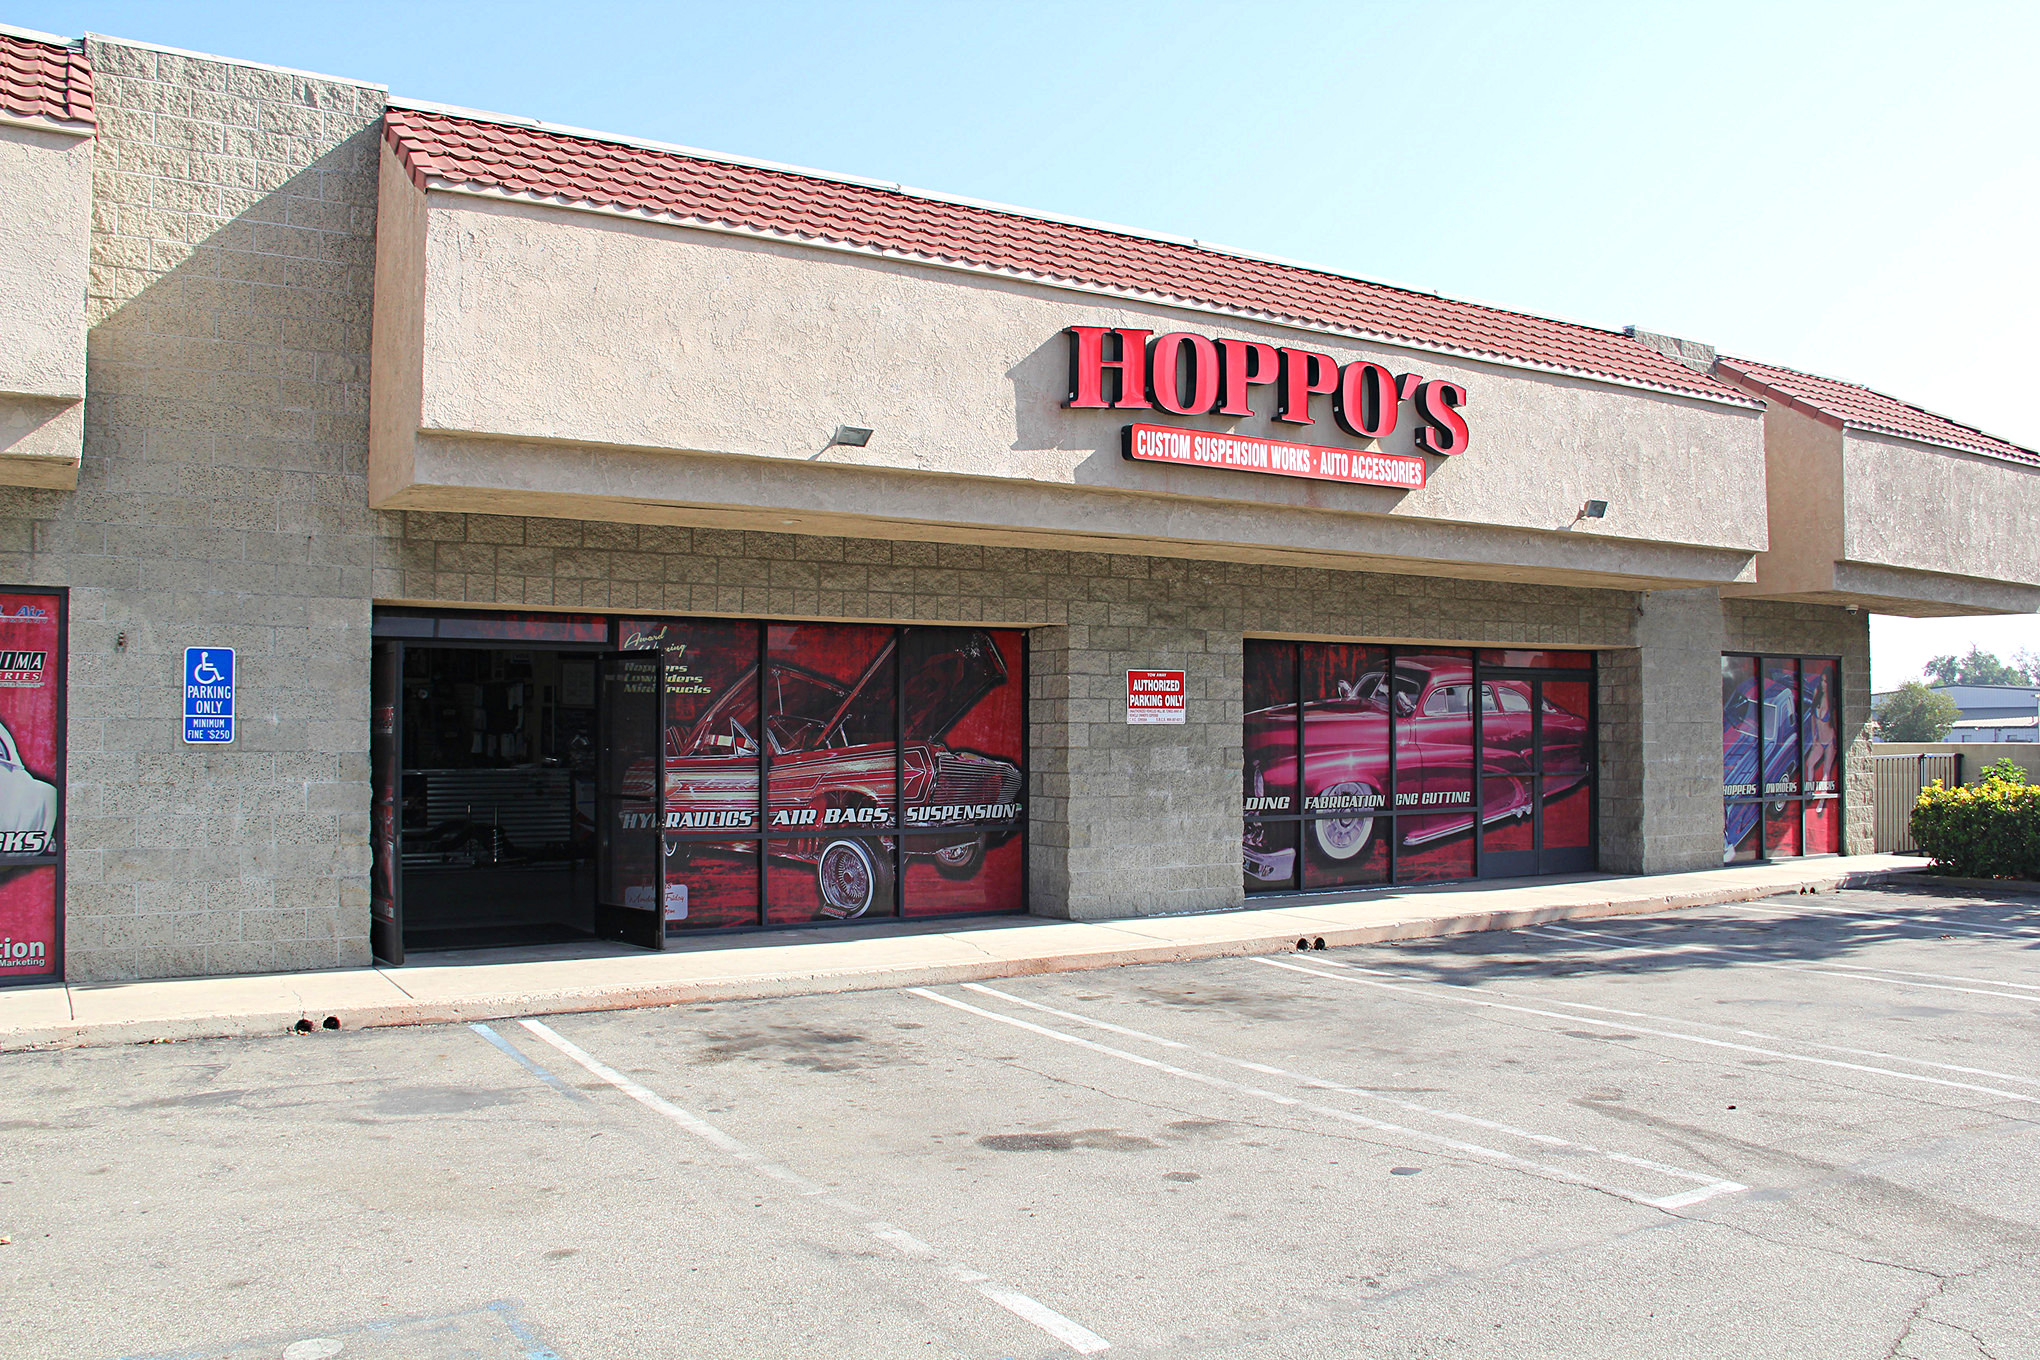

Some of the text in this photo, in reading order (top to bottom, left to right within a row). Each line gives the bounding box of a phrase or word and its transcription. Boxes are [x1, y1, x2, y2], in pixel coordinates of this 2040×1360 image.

[1062, 326, 1469, 457] HOPPO'S
[1137, 429, 1422, 485] CUSTOM SUSPENSION WORKS AUTO ACCESSORIES
[16, 605, 46, 617] Air
[624, 626, 668, 649] Award
[0, 653, 43, 669] IMA
[0, 672, 40, 680] RIES
[624, 673, 703, 683] Lowiders
[1133, 679, 1180, 691] AUTHORIZED
[187, 685, 231, 699] PARKING
[195, 700, 223, 714] ONLY
[1130, 695, 1184, 707] PARKING ONLY
[193, 719, 225, 728] MINIMUM
[187, 730, 230, 739] FINE $250
[1723, 784, 1757, 796] HOPPERS
[1243, 796, 1291, 811] DING
[1304, 794, 1386, 810] FABRICATION
[1421, 791, 1471, 805] CUTTING
[771, 808, 818, 826] AIR
[823, 807, 889, 825] BAGS
[906, 804, 1017, 822] SUSPENSION
[0, 958, 45, 967] Marketing
